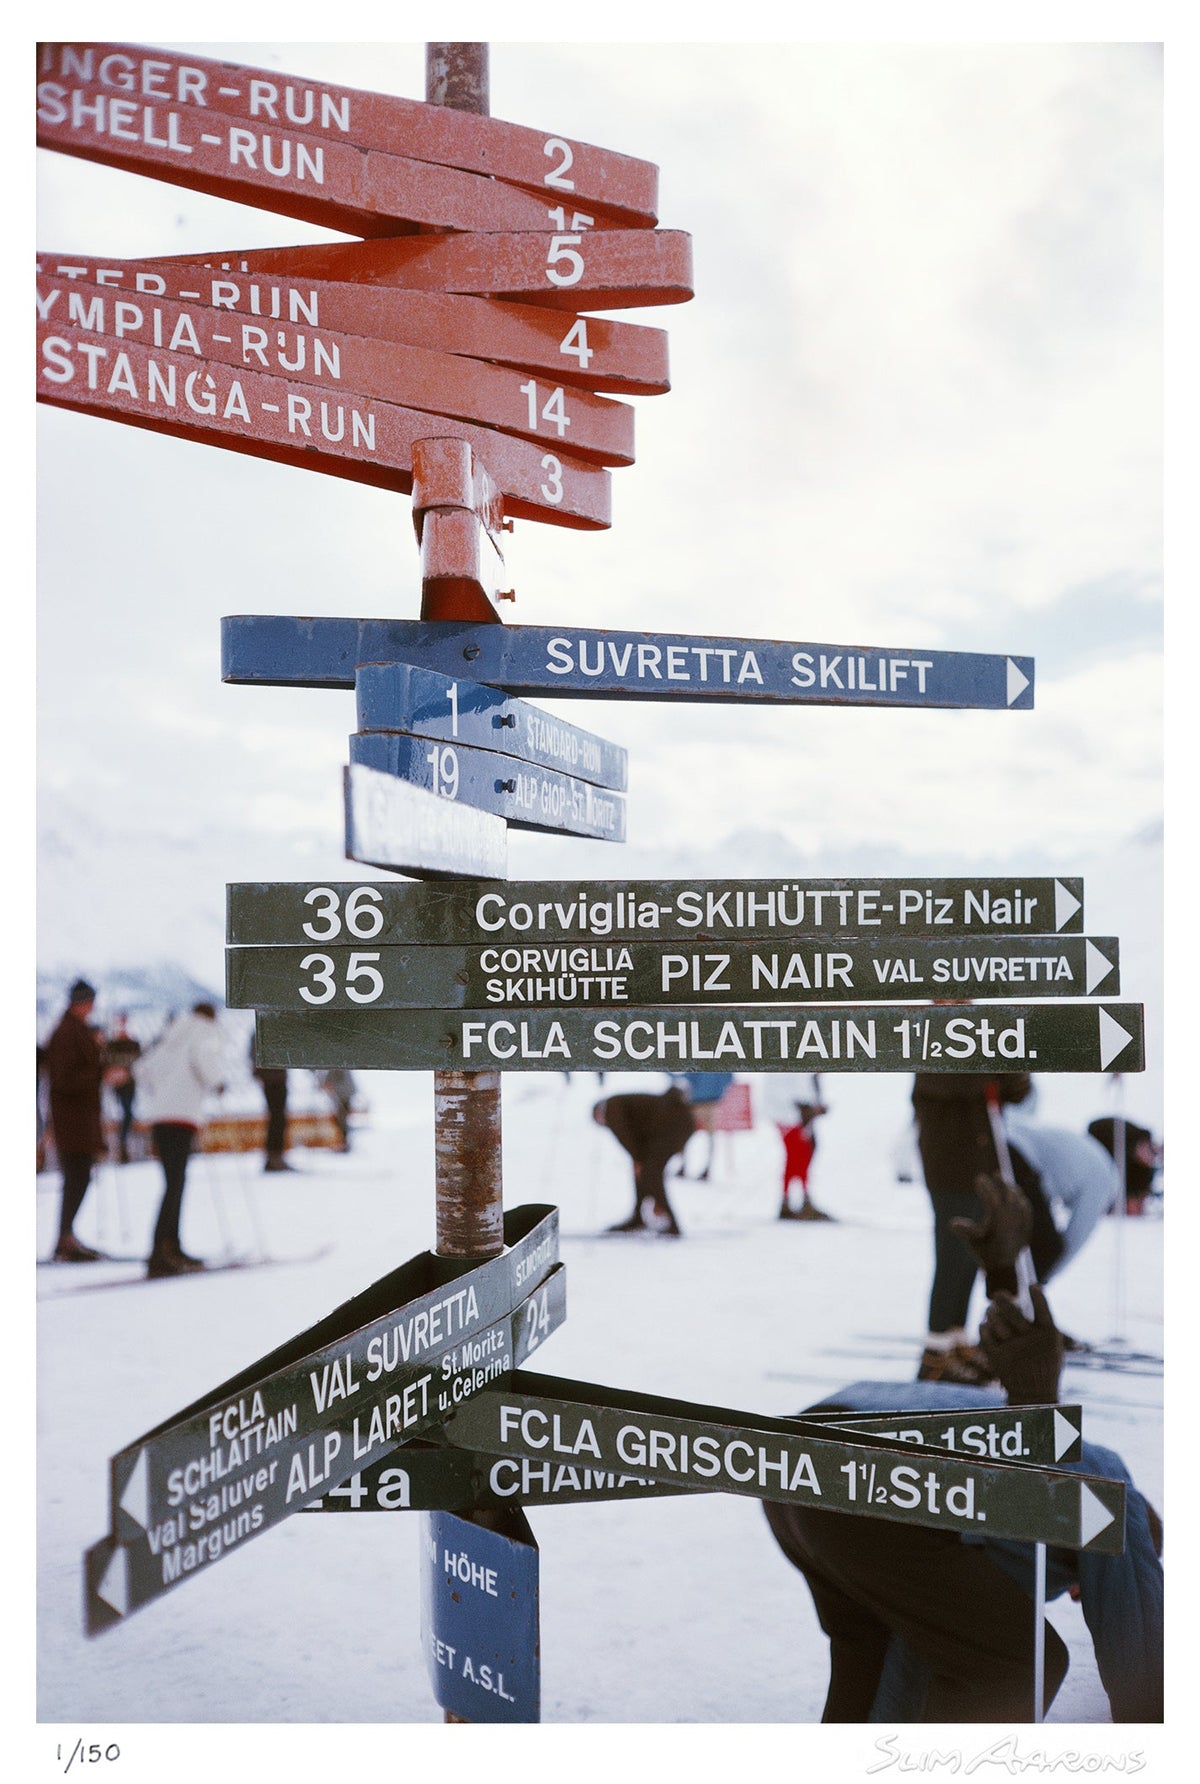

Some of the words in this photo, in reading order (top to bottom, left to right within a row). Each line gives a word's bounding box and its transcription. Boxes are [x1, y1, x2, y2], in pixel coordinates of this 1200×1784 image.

[36, 81, 324, 184] SHELL-RUN
[543, 138, 575, 190] 2
[545, 235, 585, 287] 5
[559, 320, 593, 368] 4
[42, 336, 376, 450] STANGA-RUN
[519, 380, 571, 436] 14
[540, 454, 563, 503] 3
[545, 637, 764, 685] SUVRETTA
[791, 653, 933, 693] SKILIFT
[446, 682, 458, 736] 1
[426, 746, 460, 801] 19
[515, 773, 538, 810] ALP
[302, 886, 385, 941] 36
[963, 888, 1038, 925] Nair
[298, 952, 385, 1005] 35
[480, 948, 634, 974] CORVIGLIA
[486, 973, 628, 1002] SKIHÜTTE
[661, 955, 731, 992] PIZ
[751, 953, 855, 990] NAIR
[872, 959, 924, 983] VAL
[931, 955, 1074, 983] SUVRETTA
[461, 1021, 572, 1059] FCLA
[592, 1019, 877, 1060] SCHLATTAIN
[527, 1287, 550, 1351] 24
[310, 1354, 360, 1415] VAL
[366, 1285, 480, 1383] SUVRETTA
[209, 1390, 266, 1448] FCLA
[285, 1431, 342, 1504] ALP
[353, 1373, 432, 1461] LARET
[166, 1403, 298, 1507] SCHLATTAIN
[500, 1405, 602, 1458] FCLA
[616, 1425, 823, 1496] GRISCHA
[189, 1460, 278, 1531] Saluver
[304, 1468, 411, 1509] 4a
[489, 1458, 656, 1497] CHAM
[162, 1503, 265, 1585] Marguns
[444, 1549, 498, 1597] HÖHE
[462, 1656, 515, 1703] A.S.L.
[57, 1738, 121, 1774] 1/150
